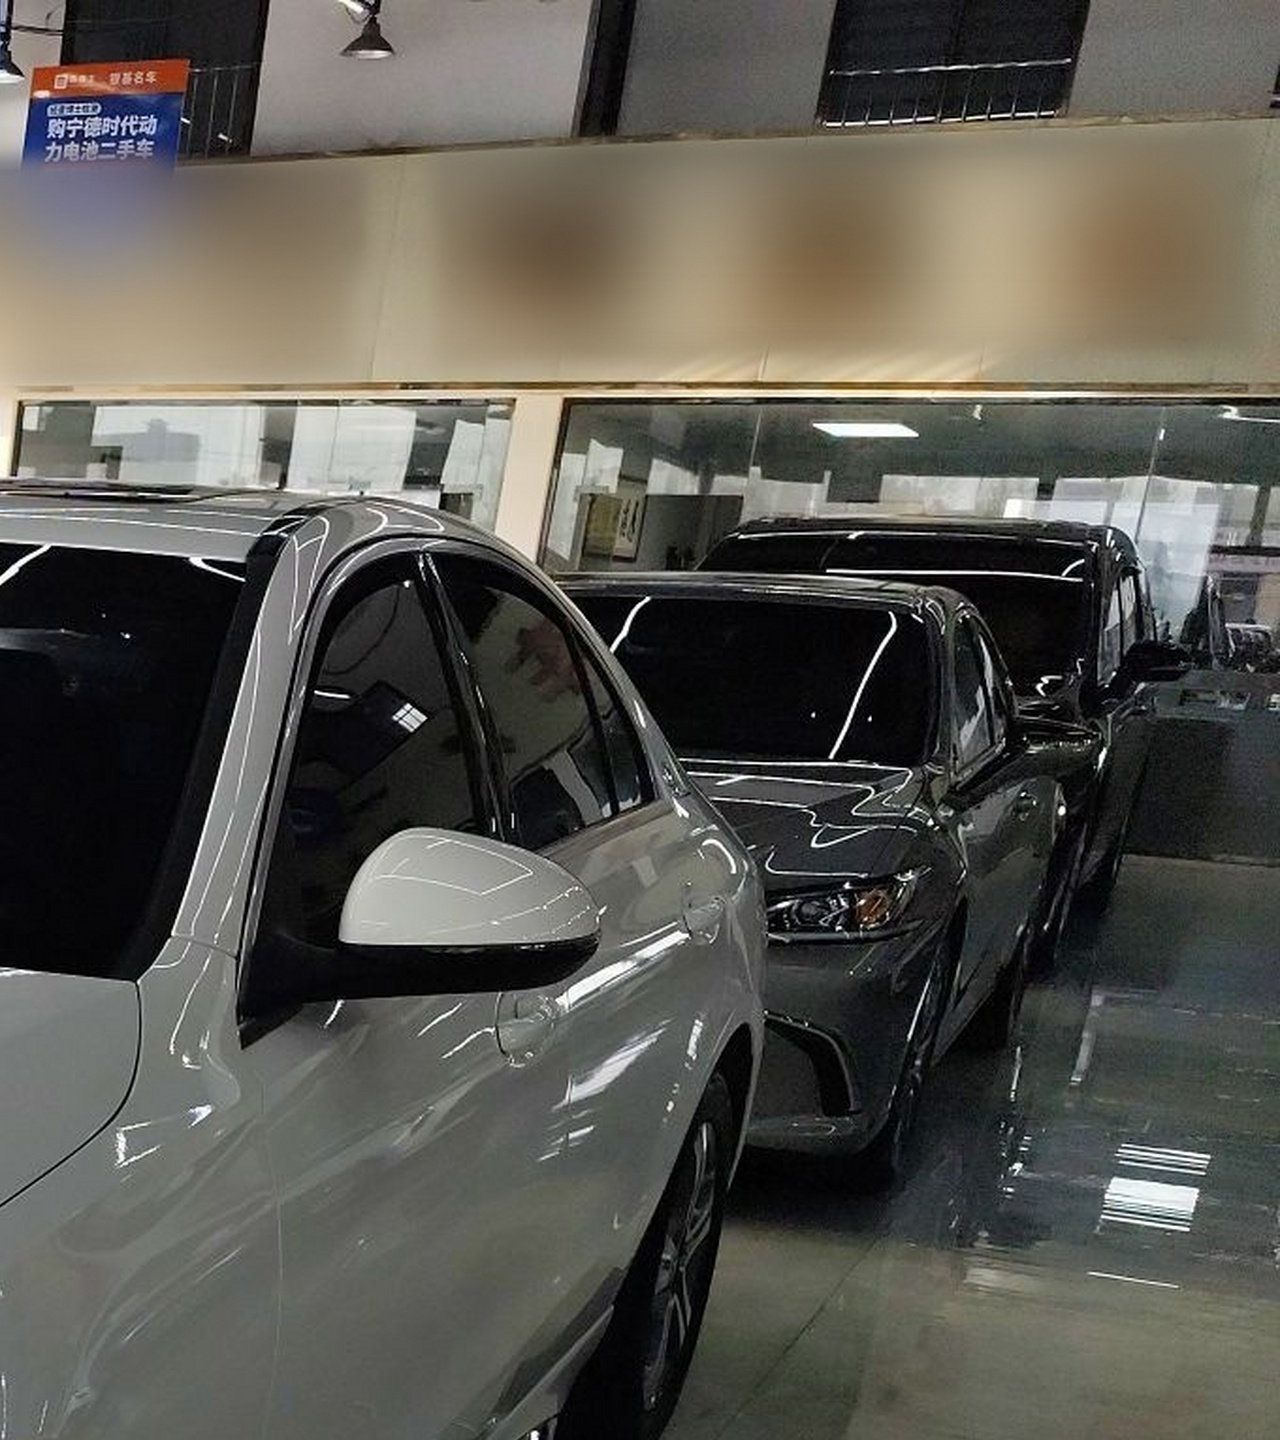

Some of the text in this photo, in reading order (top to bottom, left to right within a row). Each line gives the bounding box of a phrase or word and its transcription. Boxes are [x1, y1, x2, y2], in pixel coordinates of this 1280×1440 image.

[46, 115, 159, 139] 购宁德时代动
[44, 138, 155, 163] 力电池二手车
